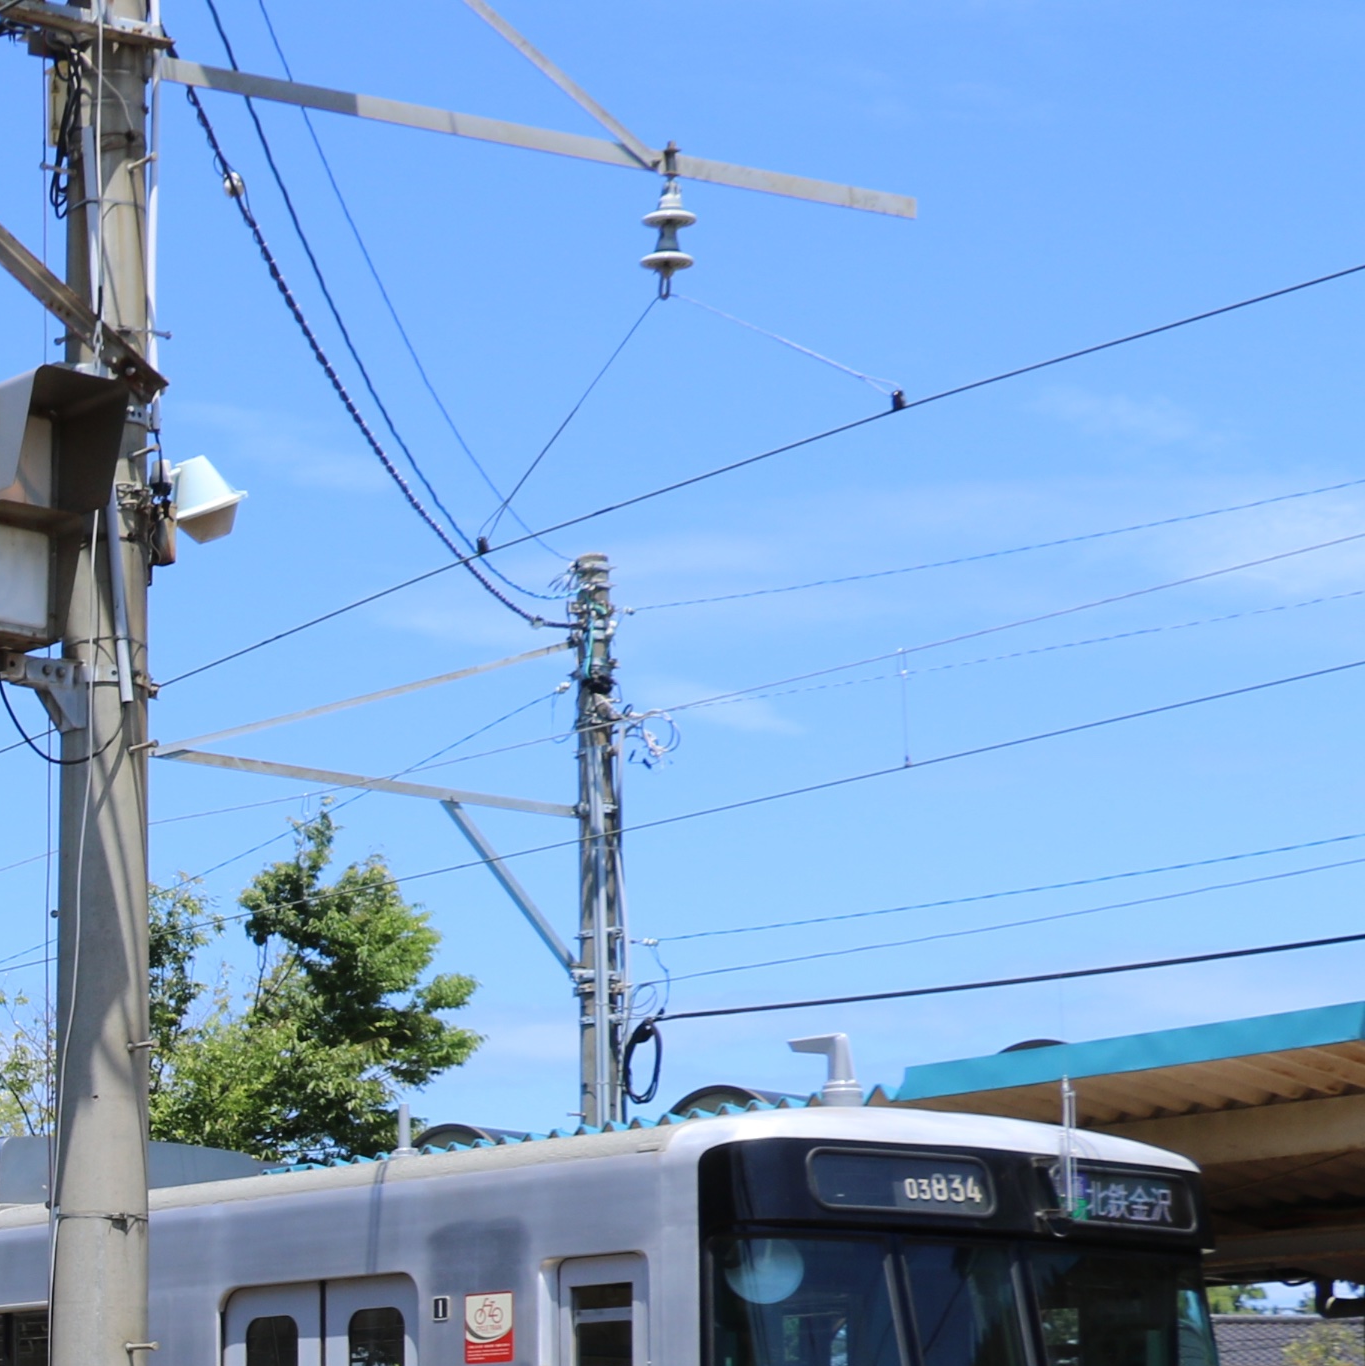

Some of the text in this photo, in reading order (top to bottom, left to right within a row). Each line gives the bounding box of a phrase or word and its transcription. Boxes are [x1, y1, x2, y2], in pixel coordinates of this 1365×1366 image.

[904, 1173, 983, 1203] 03834
[1085, 1180, 1173, 1223] 北鉄金沢
